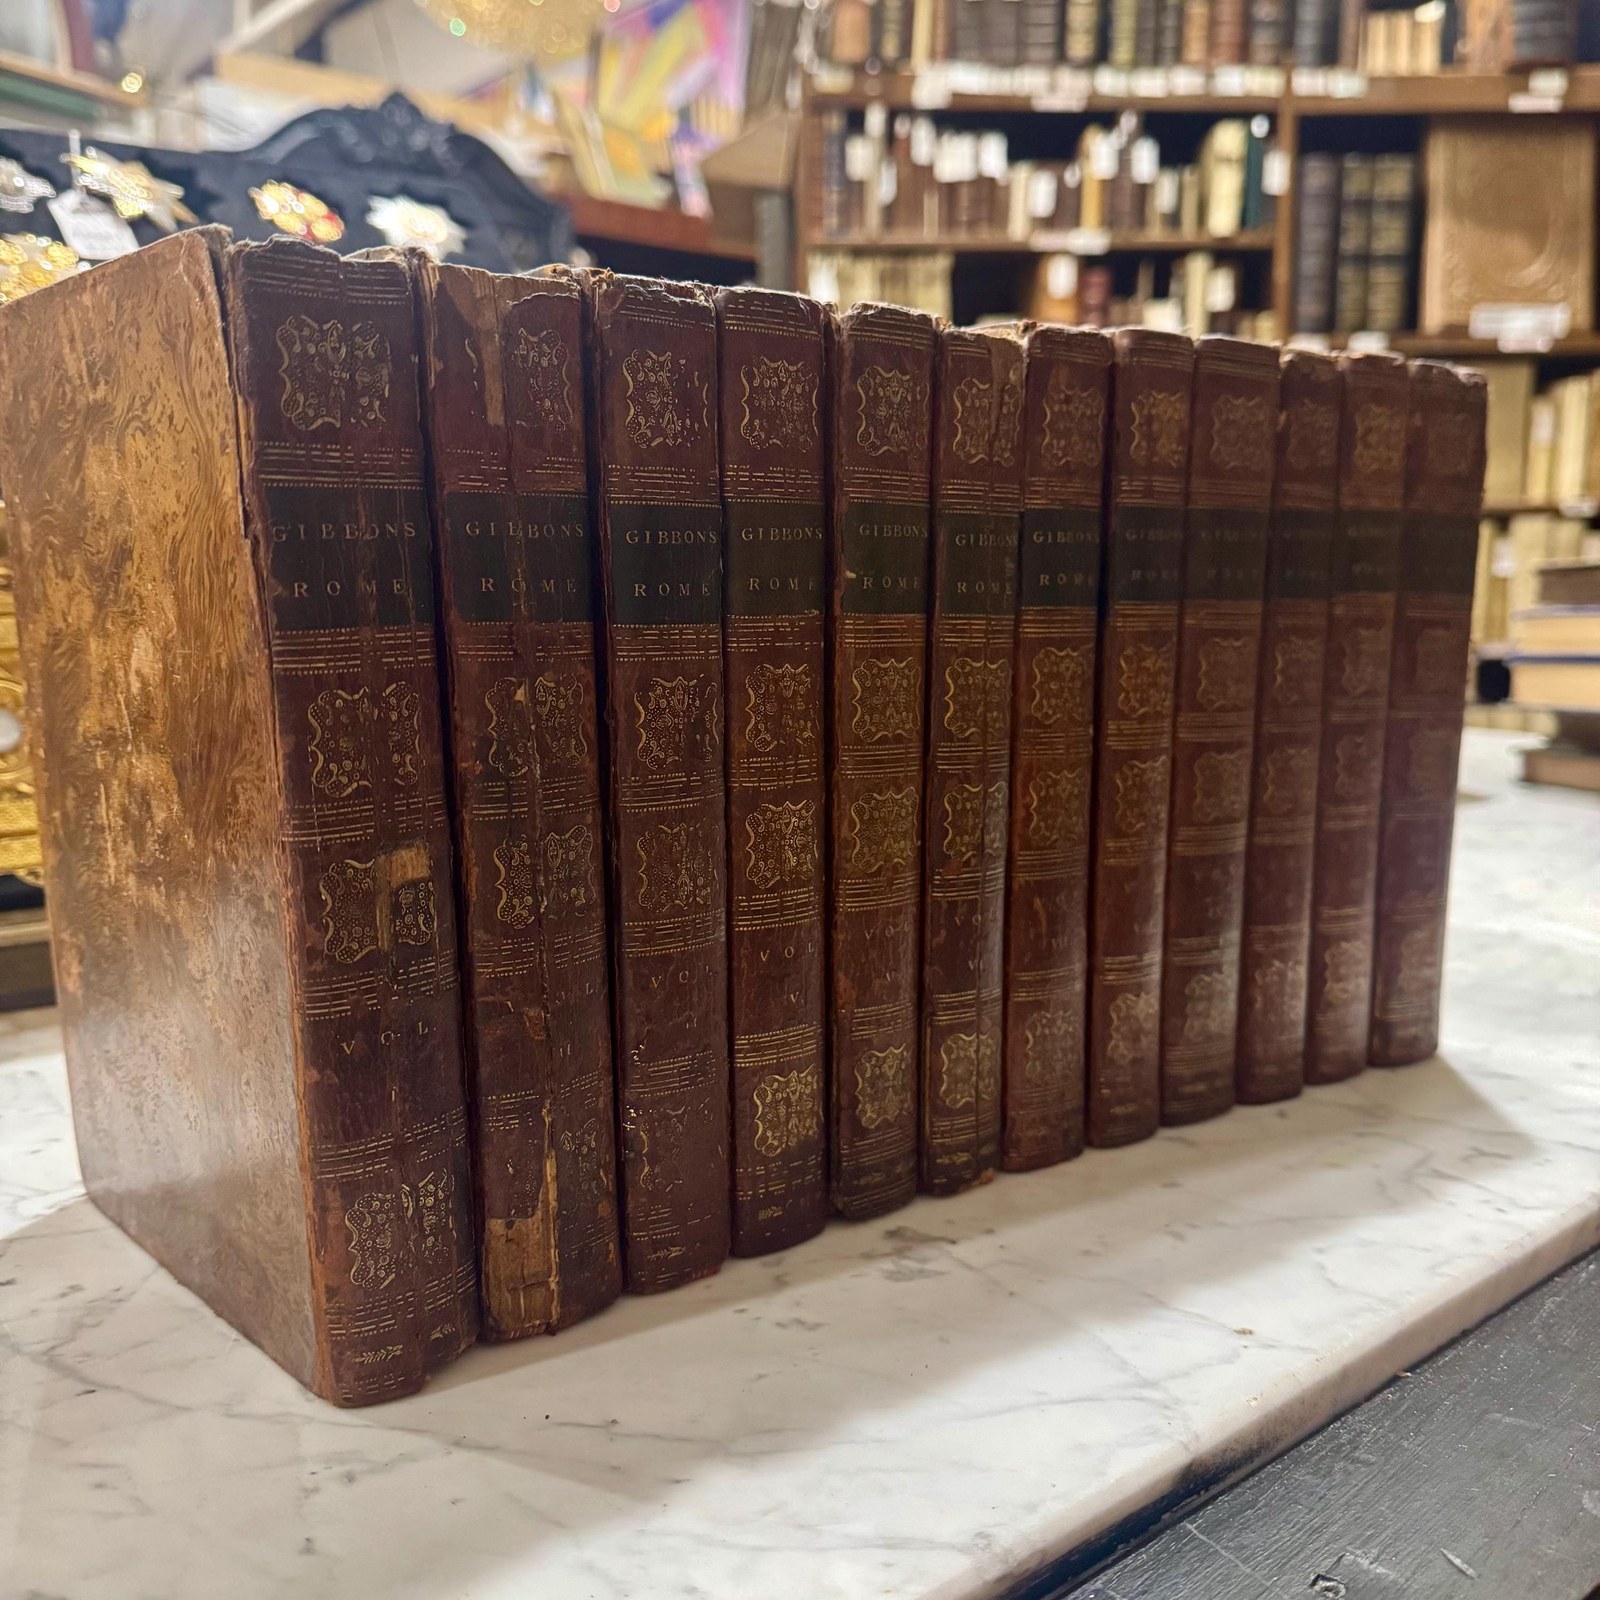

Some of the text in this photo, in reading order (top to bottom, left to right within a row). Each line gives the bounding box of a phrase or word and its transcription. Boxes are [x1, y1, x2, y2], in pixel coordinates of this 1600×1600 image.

[465, 521, 585, 539] GIBBONS
[625, 529, 718, 545] GIBBONS
[741, 527, 823, 542] GIBBONS
[859, 523, 929, 539] GIBBONS
[293, 578, 406, 599] ROME
[480, 577, 577, 594] ROME
[634, 582, 712, 598] ROME
